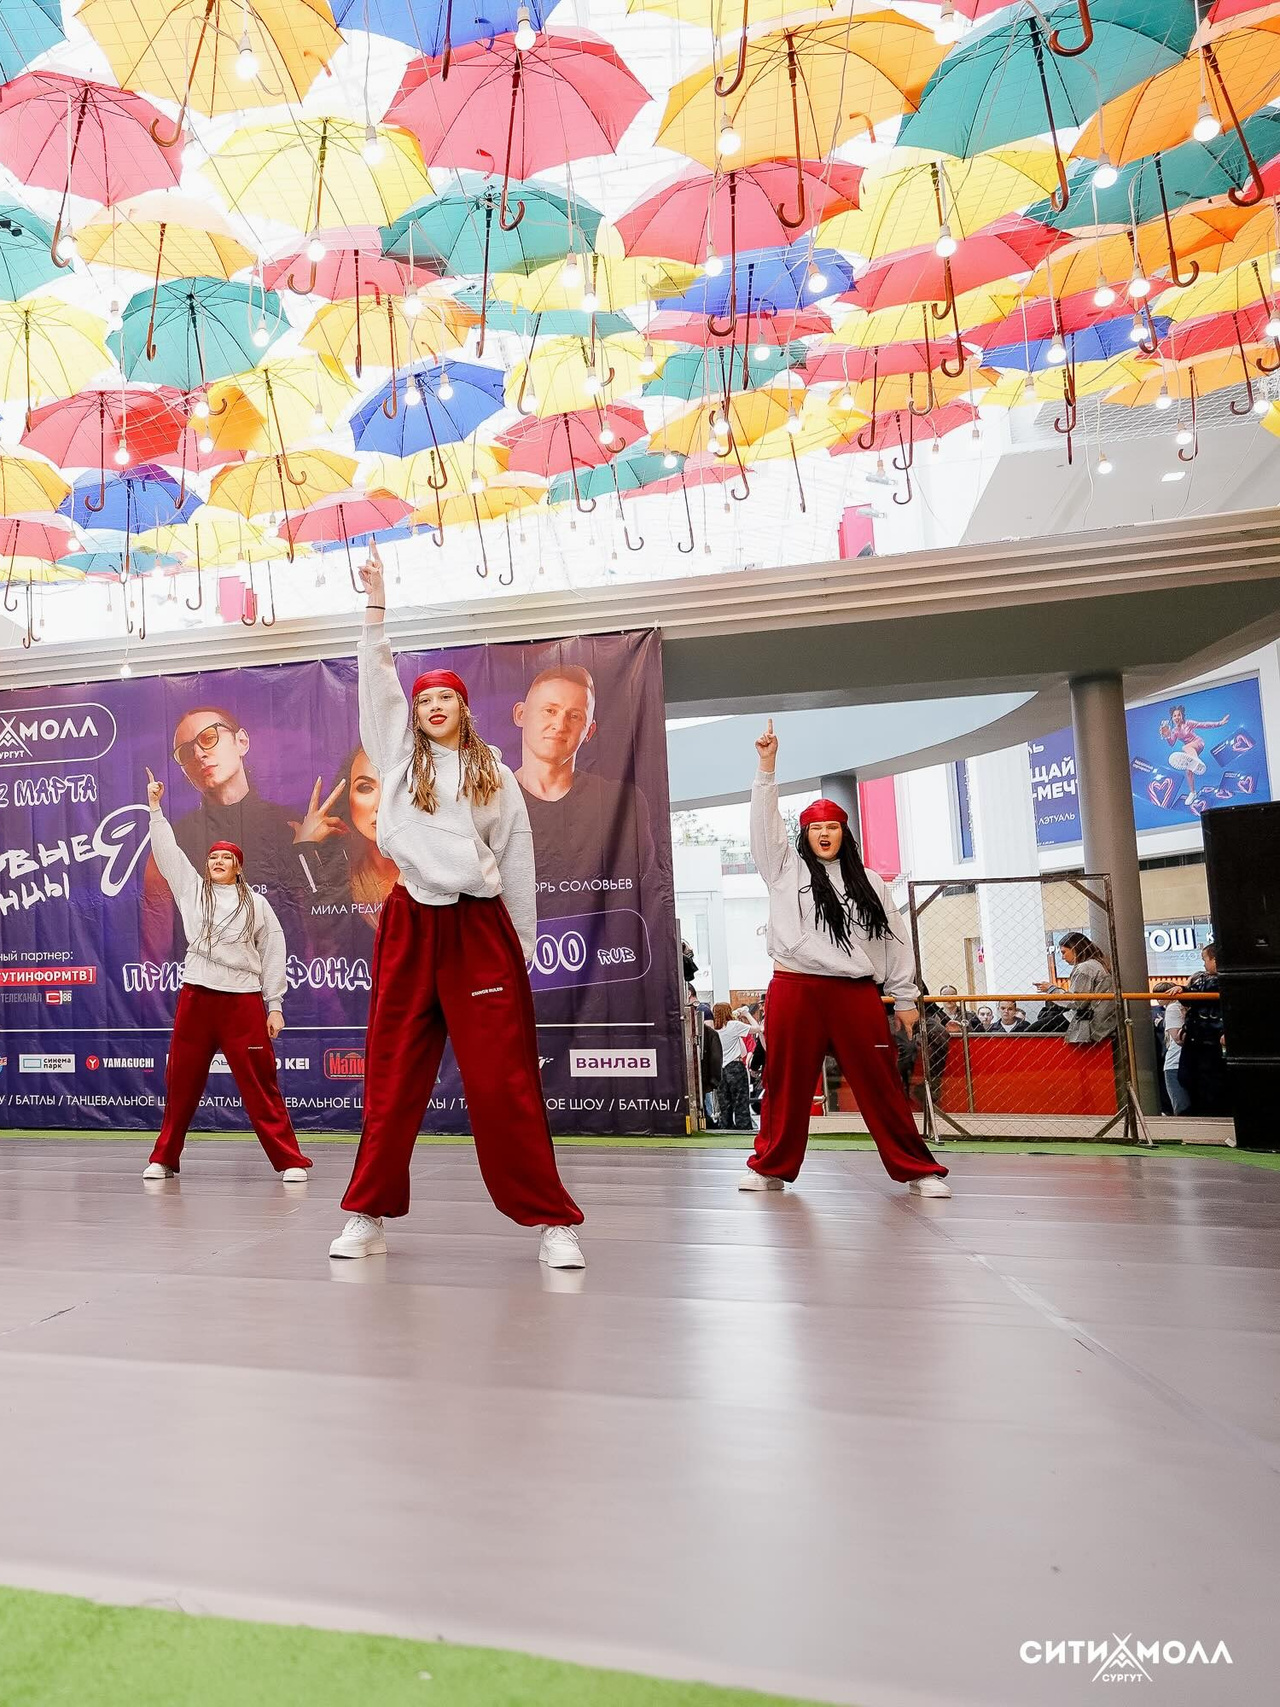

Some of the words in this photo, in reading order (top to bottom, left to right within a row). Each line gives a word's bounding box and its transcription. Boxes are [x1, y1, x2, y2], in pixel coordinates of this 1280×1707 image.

[19, 716, 99, 742] МОЛЛ
[13, 773, 98, 807] МАРТА
[1038, 812, 1076, 826] ЛЭТУАЛЬ
[559, 878, 633, 893] СОЛОВЬЕВ
[310, 902, 348, 916] МИЛА
[351, 902, 384, 915] РЕДИ
[20, 950, 74, 963] партнер:
[526, 930, 587, 975] 00
[597, 946, 637, 966] RUB
[0, 992, 43, 1004] ТЕЛЕКАНАЛ
[102, 1057, 155, 1068] YAMAGUCHI
[285, 1057, 310, 1070] KEI
[328, 1052, 366, 1075] Мали
[575, 1056, 652, 1069] ванлав
[15, 1094, 56, 1105] БАТТЛЫ
[66, 1095, 155, 1107] ТАНЦЕВАЛЬНОЕ
[285, 1097, 351, 1109] ЕВАЛЬНОЕ
[569, 1098, 605, 1111] ШОУ
[619, 1098, 671, 1111] БАТТЛЫ
